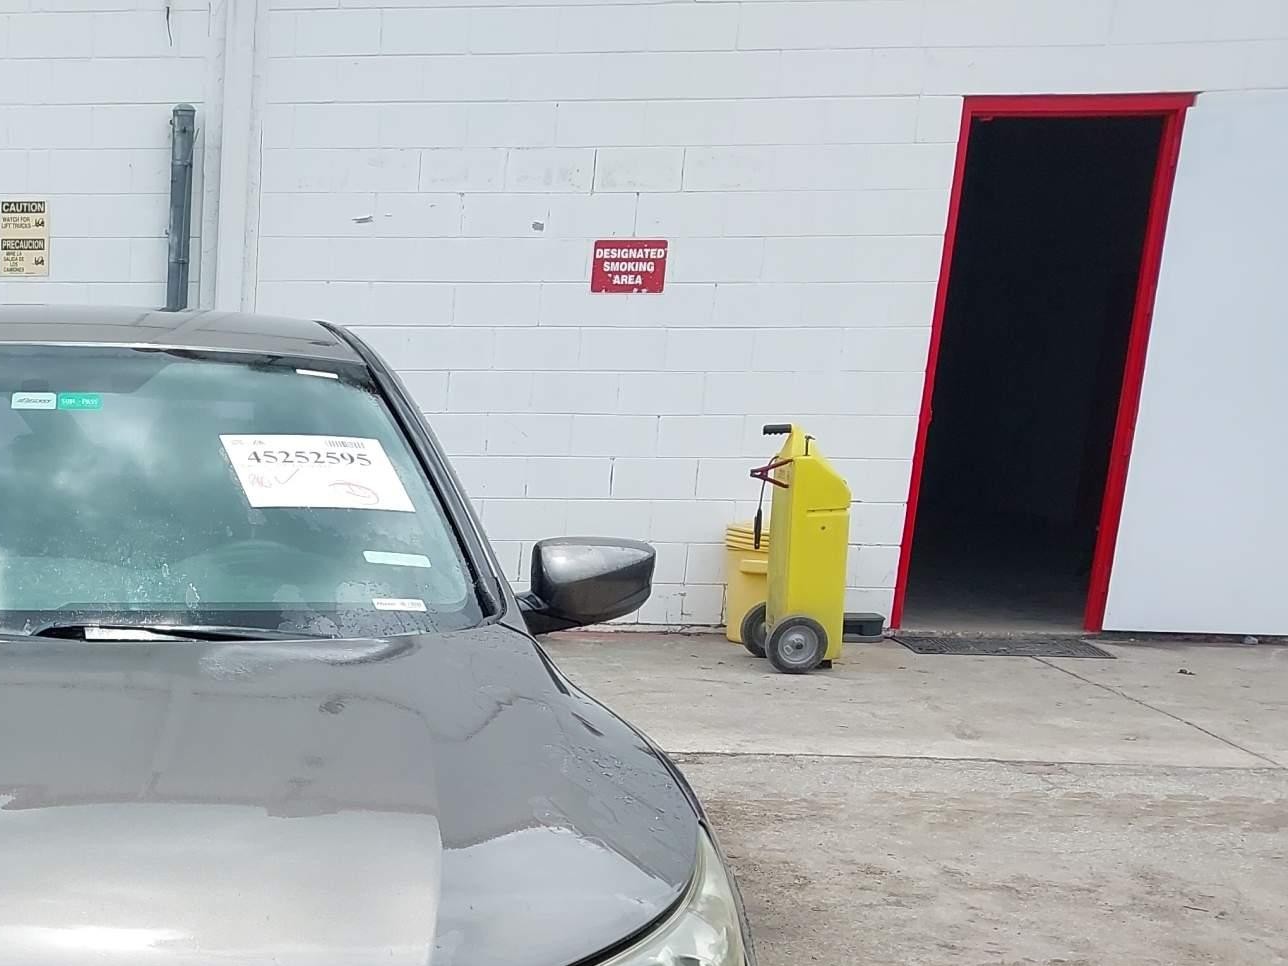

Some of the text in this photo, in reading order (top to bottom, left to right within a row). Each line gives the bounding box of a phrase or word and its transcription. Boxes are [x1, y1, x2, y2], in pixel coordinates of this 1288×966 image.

[3, 203, 45, 212] CAUTION
[2, 239, 44, 250] PRECAUCION
[595, 248, 665, 259] DESIGNATED
[603, 261, 655, 272] SMOKING
[612, 274, 643, 285] AREA
[247, 450, 372, 467] 45252595
